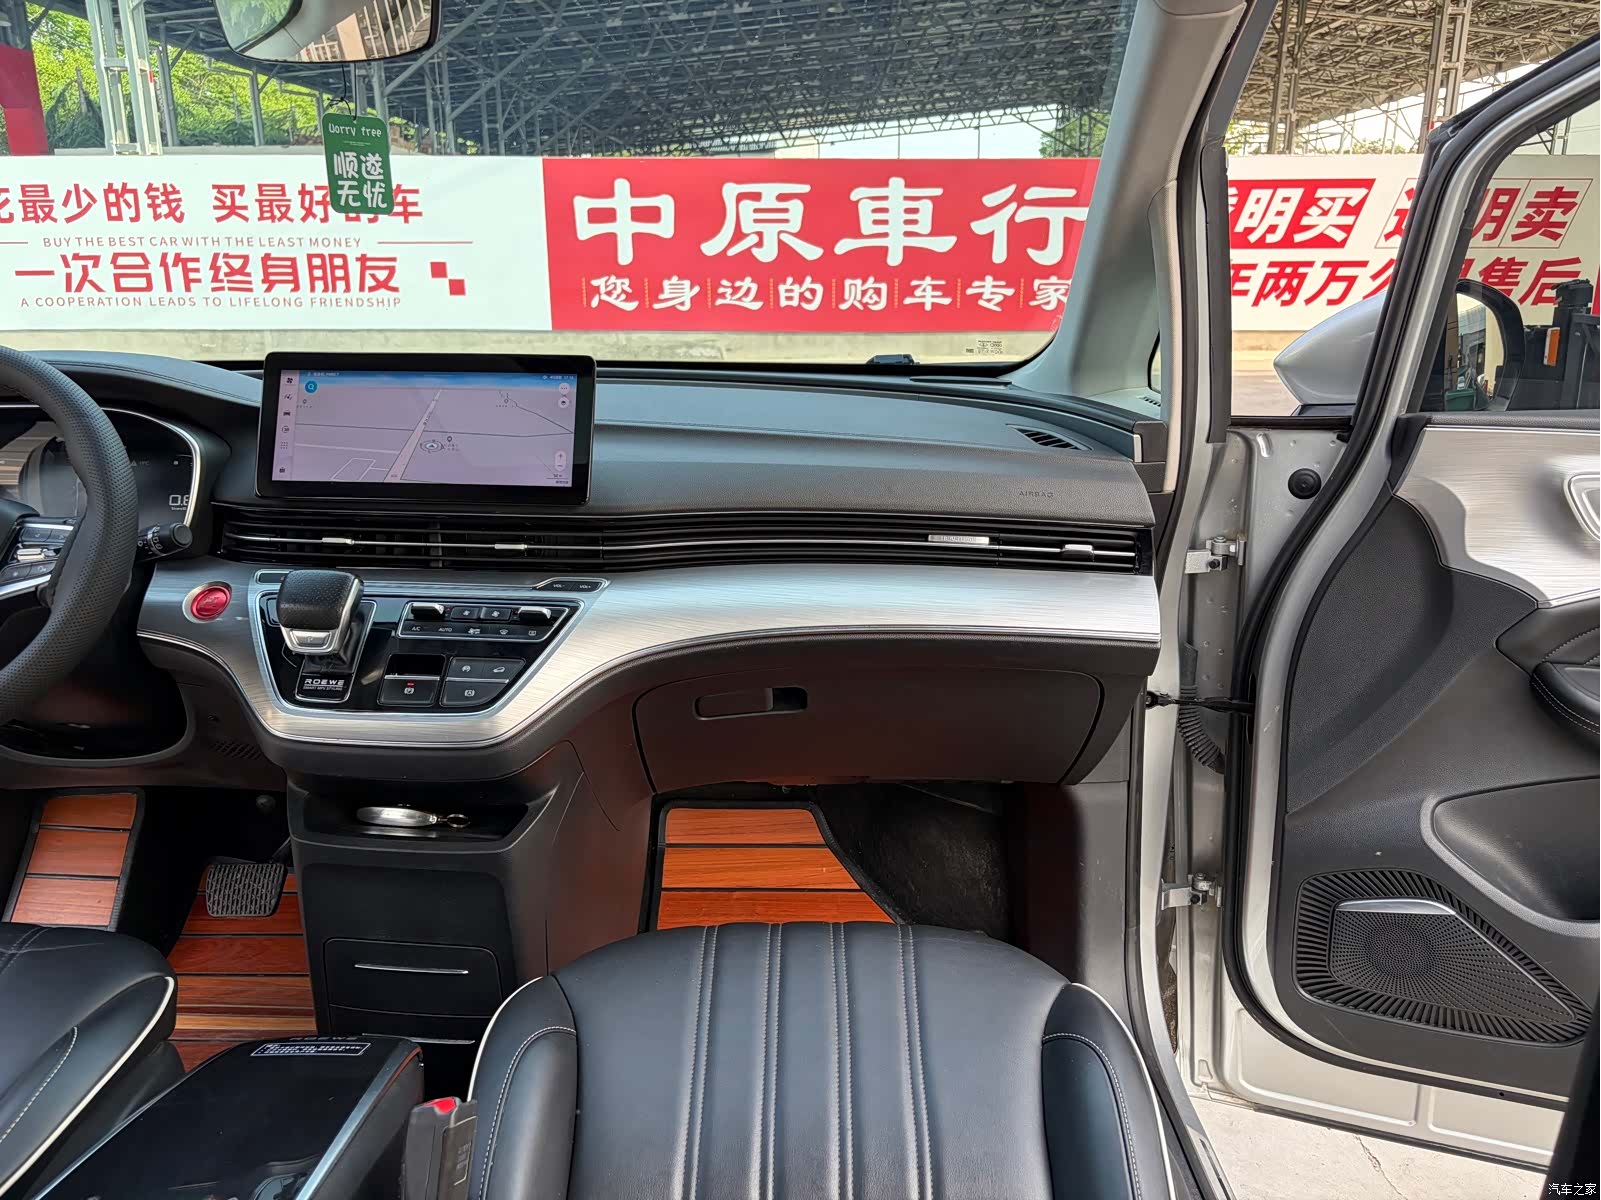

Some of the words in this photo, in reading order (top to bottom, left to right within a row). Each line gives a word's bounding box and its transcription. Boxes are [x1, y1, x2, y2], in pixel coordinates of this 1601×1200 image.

[361, 126, 382, 137] free
[212, 183, 423, 224] 买最好车
[337, 180, 388, 208] 无忧
[573, 177, 1090, 266] 中原車行
[1229, 186, 1369, 244] 明买
[43, 237, 73, 248] BUY
[75, 237, 104, 247] THE
[109, 237, 145, 247] BEST
[150, 237, 178, 247] CAR
[182, 237, 221, 247] WITH
[224, 237, 254, 247] THE
[259, 237, 304, 248] LEAST
[310, 237, 361, 248] MONEY
[15, 252, 400, 294] 一次合作终身朋友
[21, 298, 29, 307] A
[35, 297, 142, 307] COOPERATION
[150, 297, 196, 307] LEADS
[203, 297, 222, 307] TO
[229, 297, 303, 307] LIFELONG
[310, 297, 401, 308] FRIENDSHIP
[590, 275, 1072, 312] 您身边的购车专家
[304, 678, 345, 686] ROEWE
